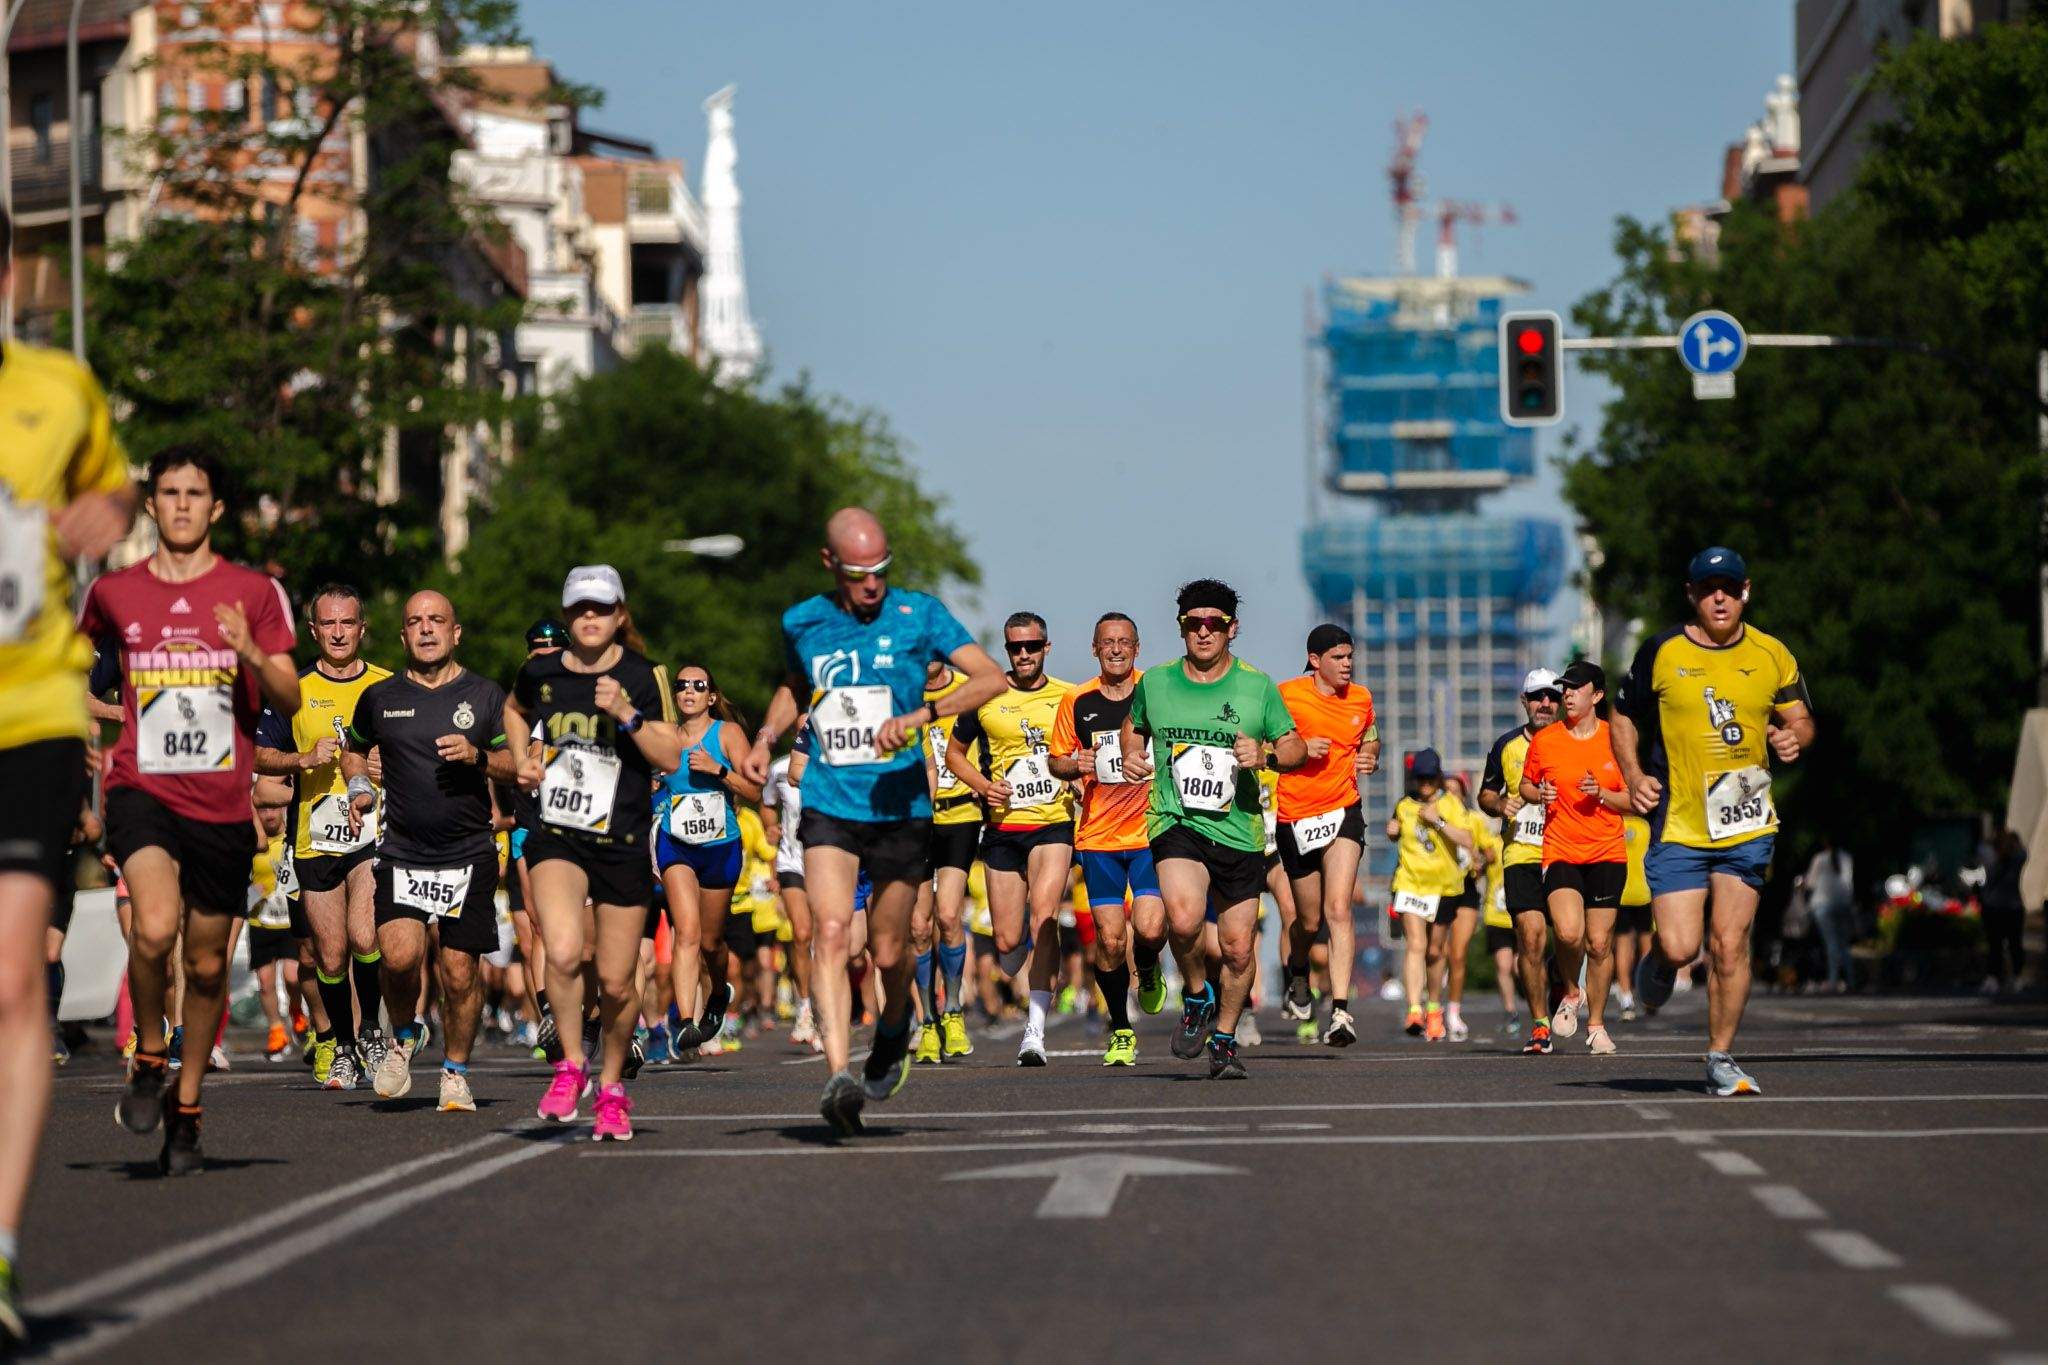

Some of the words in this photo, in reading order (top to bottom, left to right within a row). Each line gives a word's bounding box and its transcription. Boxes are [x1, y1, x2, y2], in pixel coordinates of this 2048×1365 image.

[383, 708, 415, 718] hummel
[164, 730, 207, 757] 842
[825, 727, 874, 749] 1504
[1158, 727, 1237, 743] TRIATLÓN
[1724, 727, 1740, 740] 13
[1108, 757, 1123, 773] 19
[1016, 779, 1053, 799] 3846
[1182, 777, 1223, 799] 1804
[548, 785, 593, 815] 1501
[682, 817, 716, 835] 1584
[1305, 822, 1336, 843] 2237
[1525, 821, 1543, 837] 188
[408, 878, 454, 904] 2455
